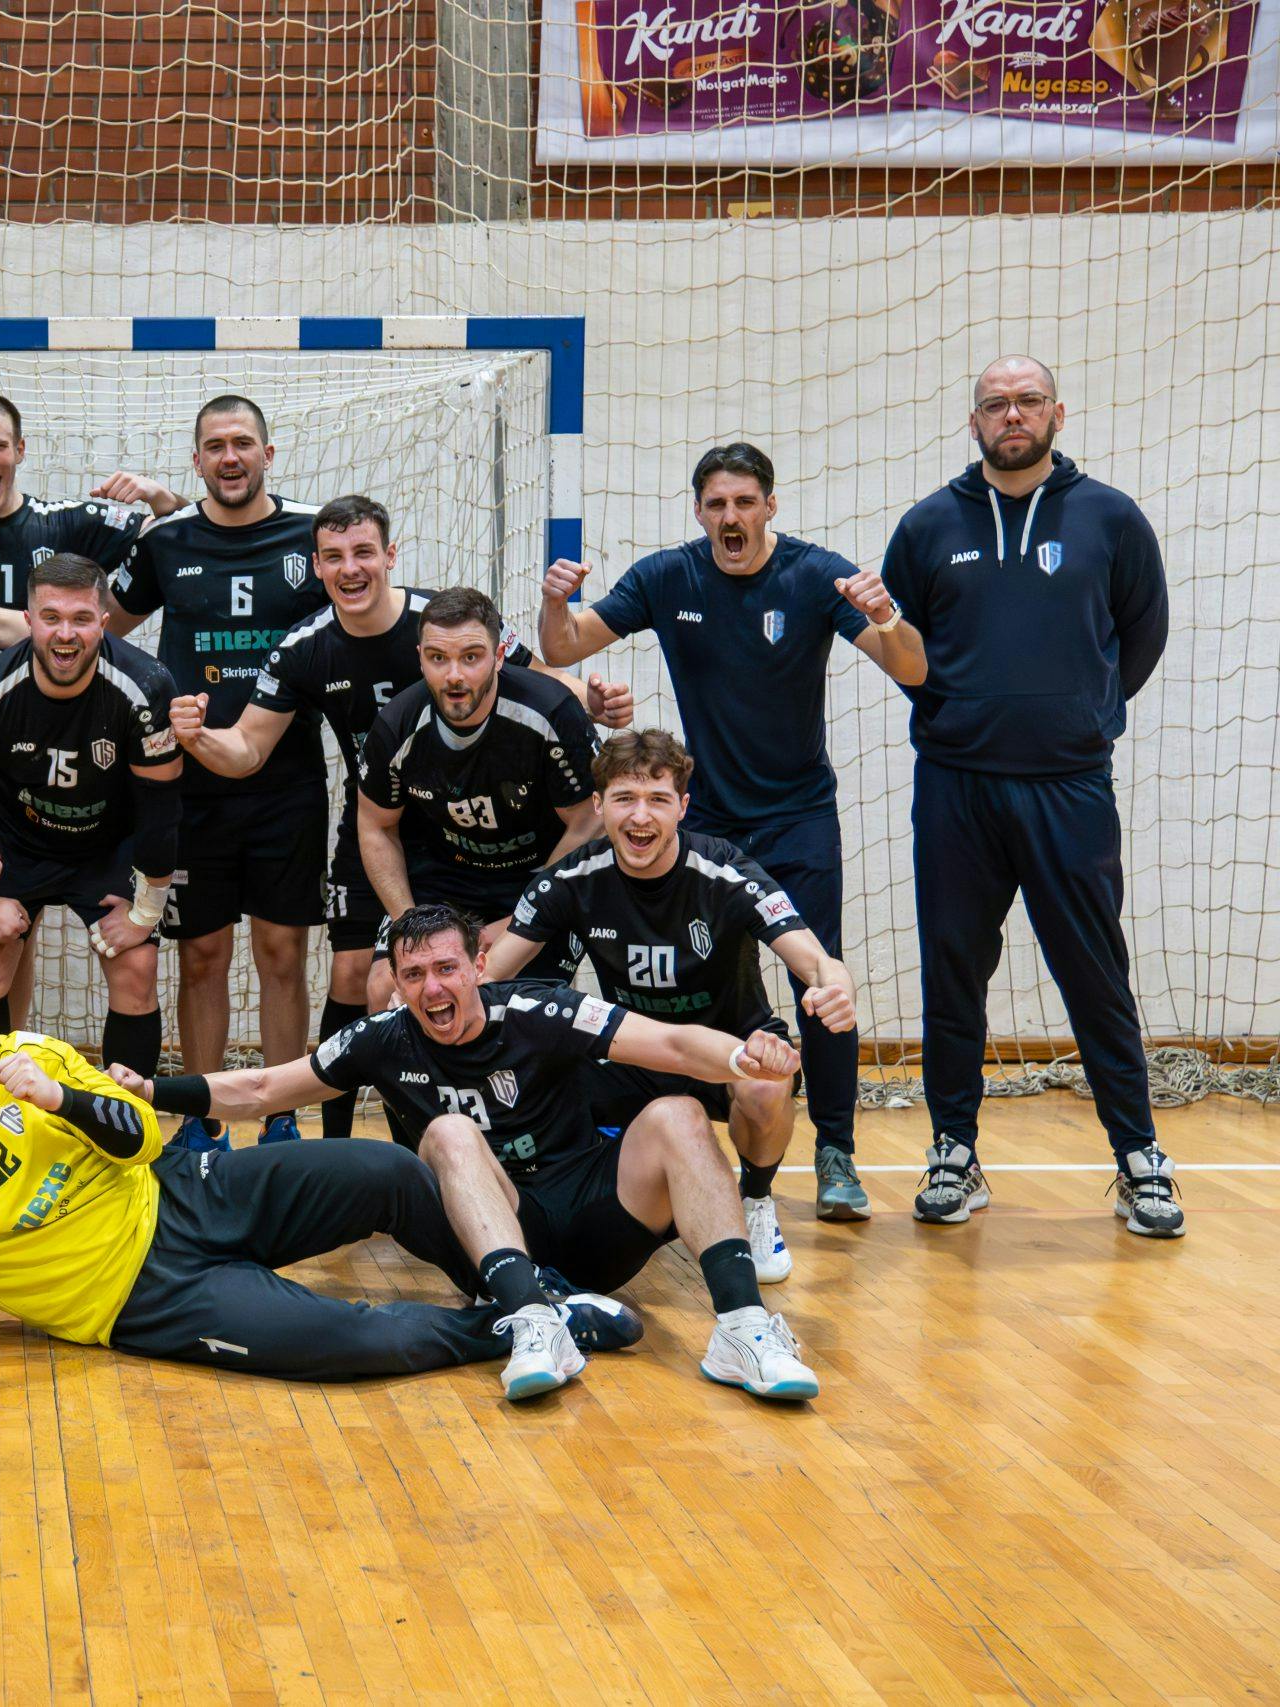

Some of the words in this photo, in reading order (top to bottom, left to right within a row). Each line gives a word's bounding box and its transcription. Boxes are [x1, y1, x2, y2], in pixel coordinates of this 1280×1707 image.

[621, 3, 761, 66] Kandi
[935, 0, 1083, 48] Kandi
[1003, 71, 1109, 99] Nugasso
[1020, 102, 1099, 115] CHAMPION
[950, 549, 980, 565] JAKO
[177, 565, 203, 577] JAKO
[231, 576, 253, 616] 6
[676, 610, 703, 624] JAKO
[325, 680, 351, 693] JAKO
[11, 742, 36, 753] JAKO
[47, 748, 78, 788] 15
[408, 786, 434, 800] JAKO
[447, 796, 498, 829] 83
[589, 927, 618, 940] JAKO
[628, 944, 678, 988] 20
[399, 1071, 430, 1084] JAKO
[497, 1133, 537, 1161] xe
[11, 1162, 72, 1233] nexe
